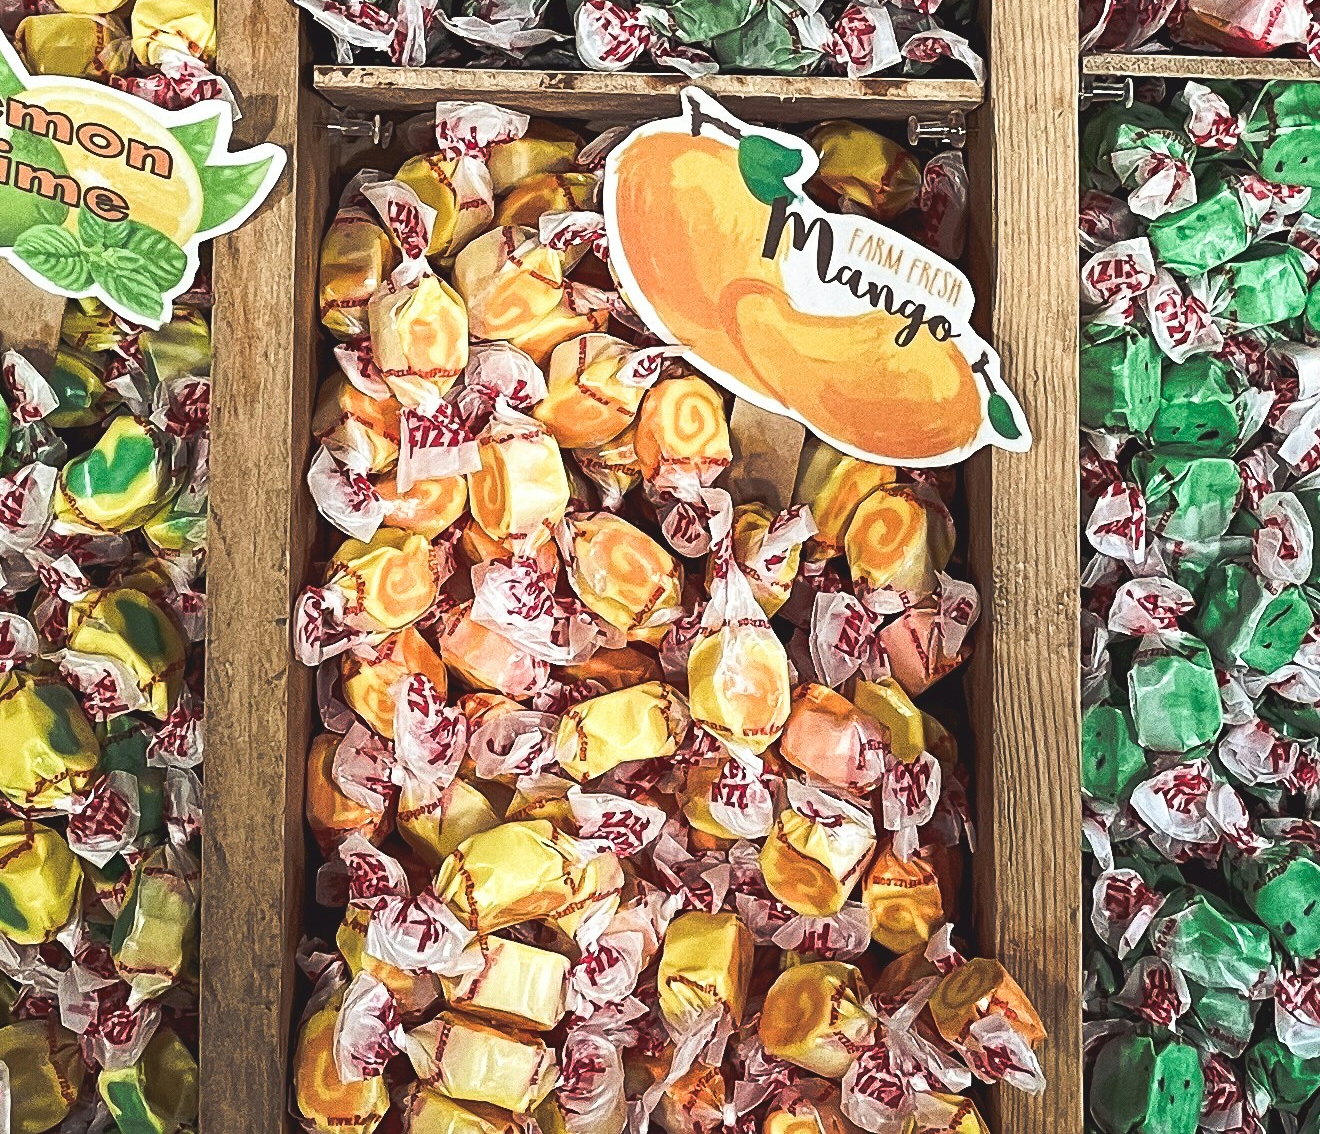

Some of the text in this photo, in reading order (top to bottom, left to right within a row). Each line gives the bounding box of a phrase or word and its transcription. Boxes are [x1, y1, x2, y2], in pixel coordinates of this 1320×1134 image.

[762, 195, 961, 348] Mango
[849, 228, 963, 307] FARM FRESH
